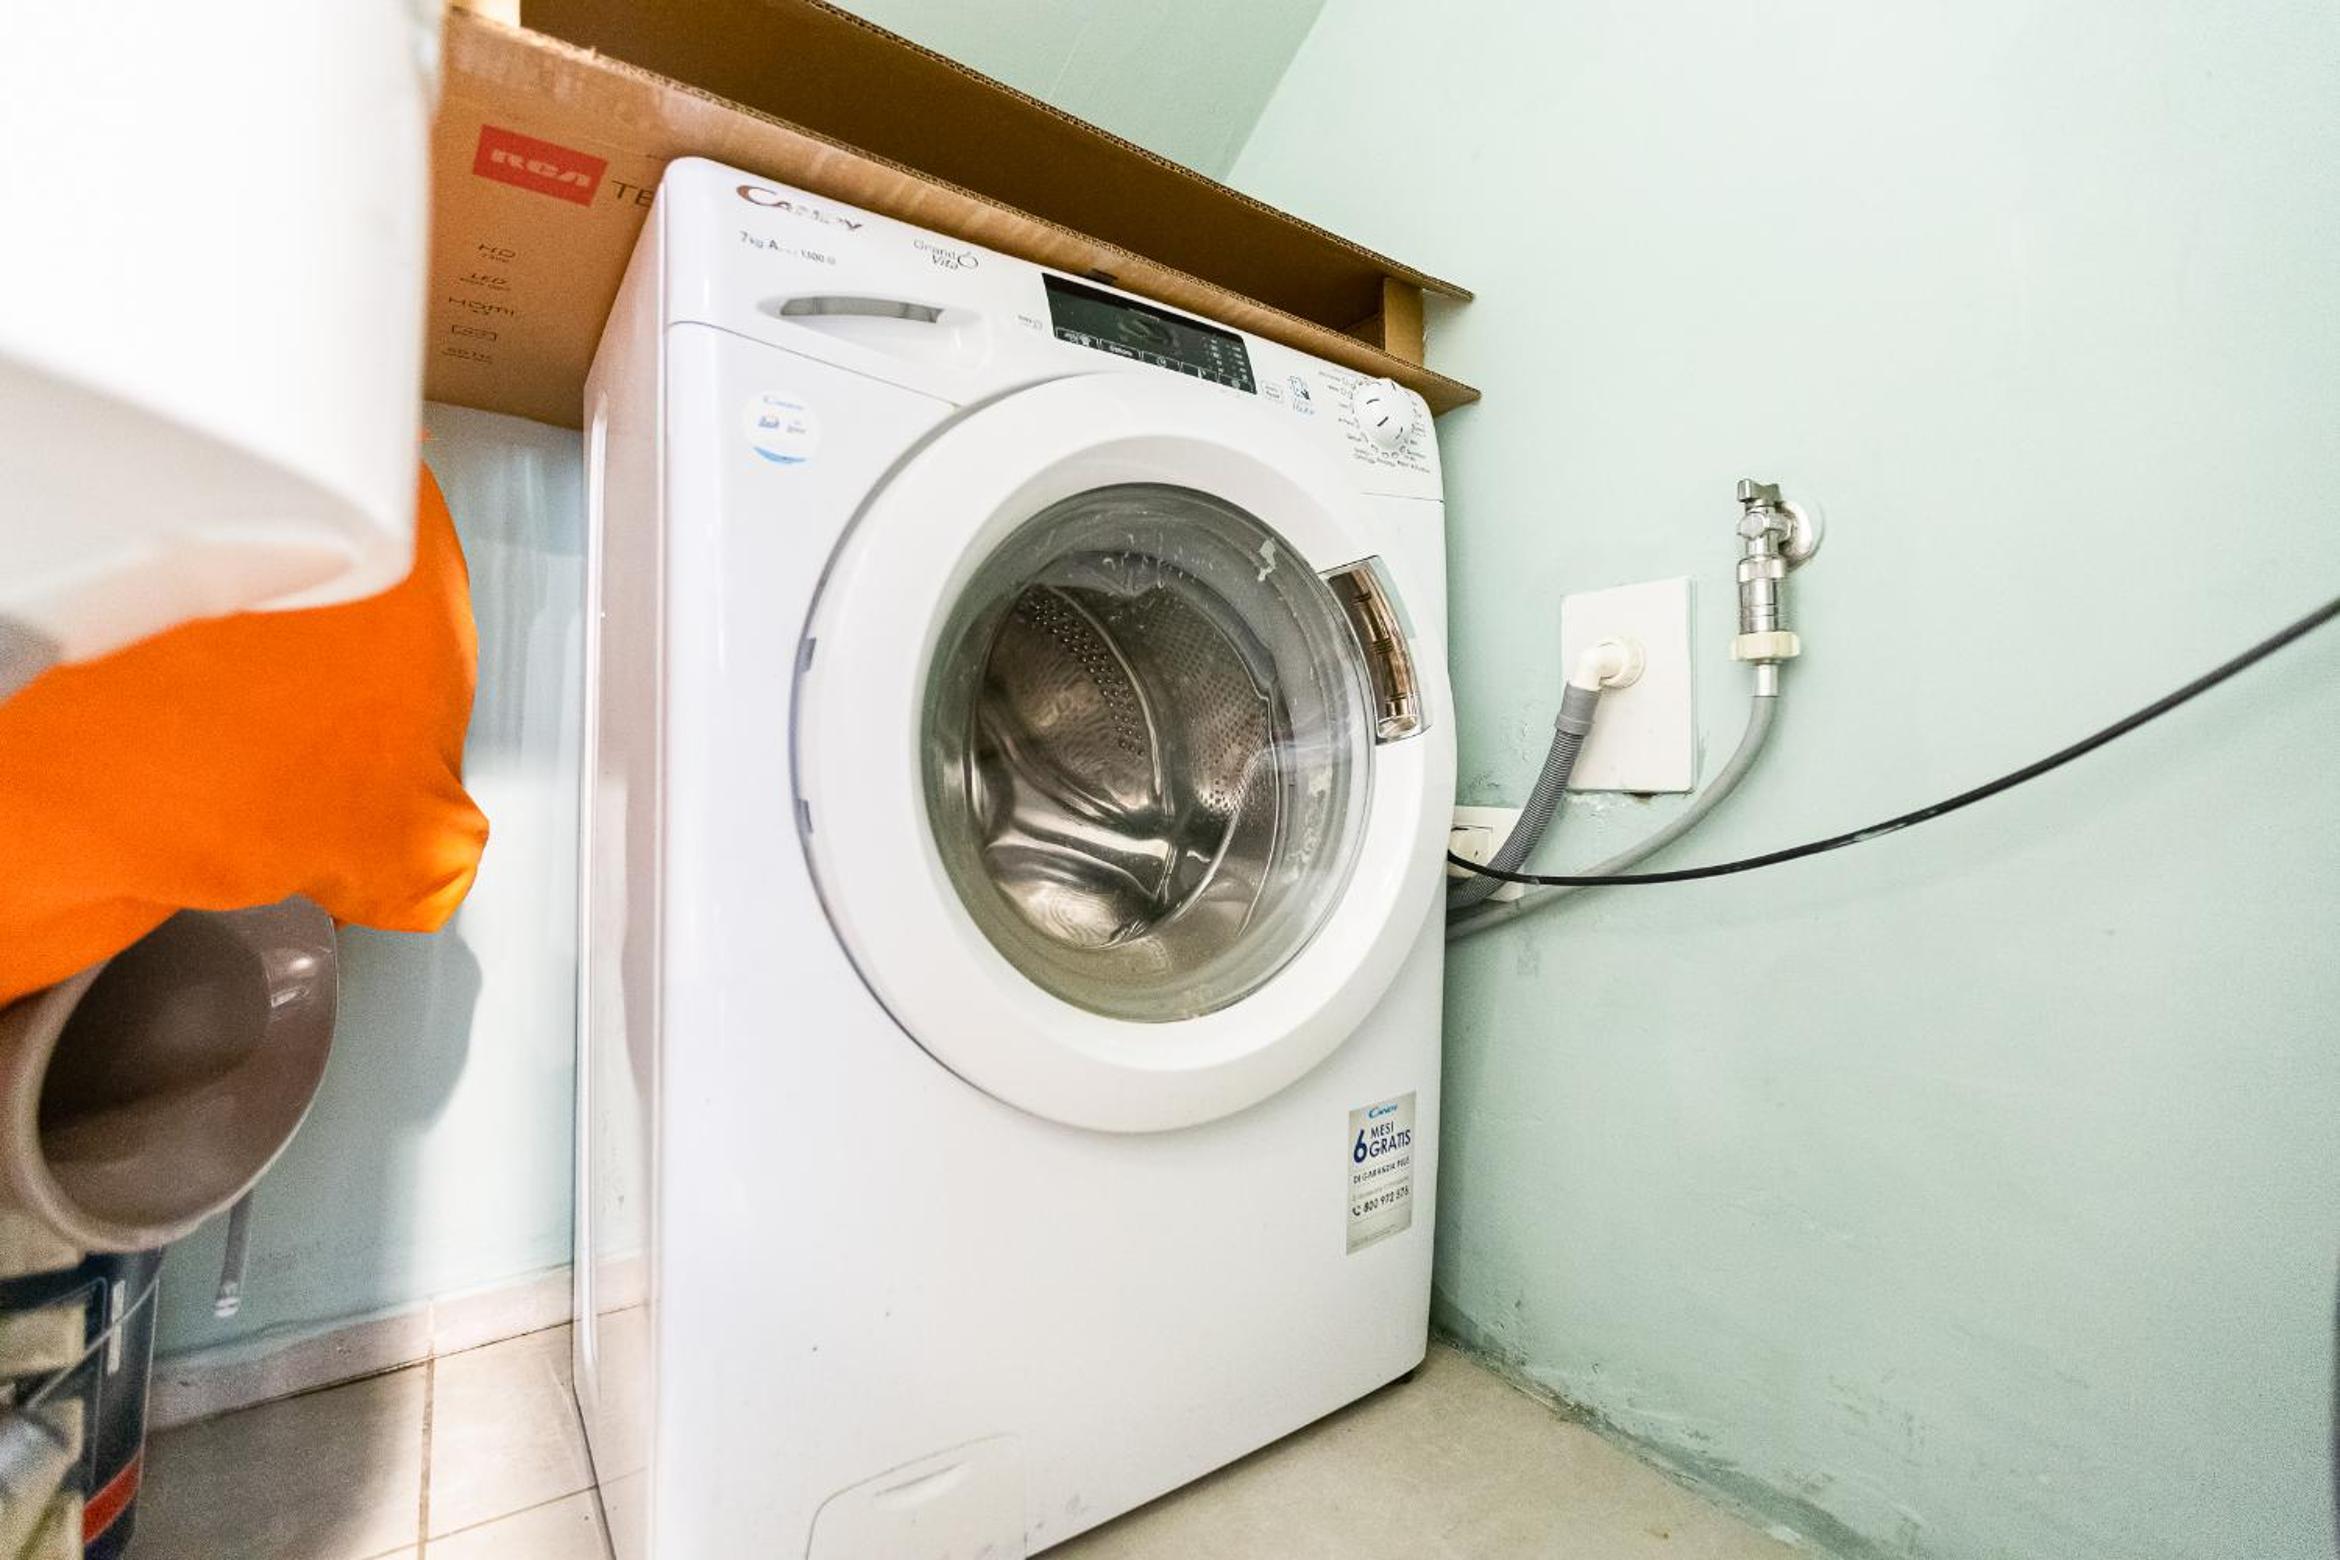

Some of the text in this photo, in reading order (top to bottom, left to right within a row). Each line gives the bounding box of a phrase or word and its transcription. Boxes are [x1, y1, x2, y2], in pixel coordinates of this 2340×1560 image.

[490, 148, 593, 188] RCA
[1353, 1129, 1368, 1163] 6
[1369, 1129, 1411, 1158] GRATIS
[1370, 1121, 1394, 1139] MESI
